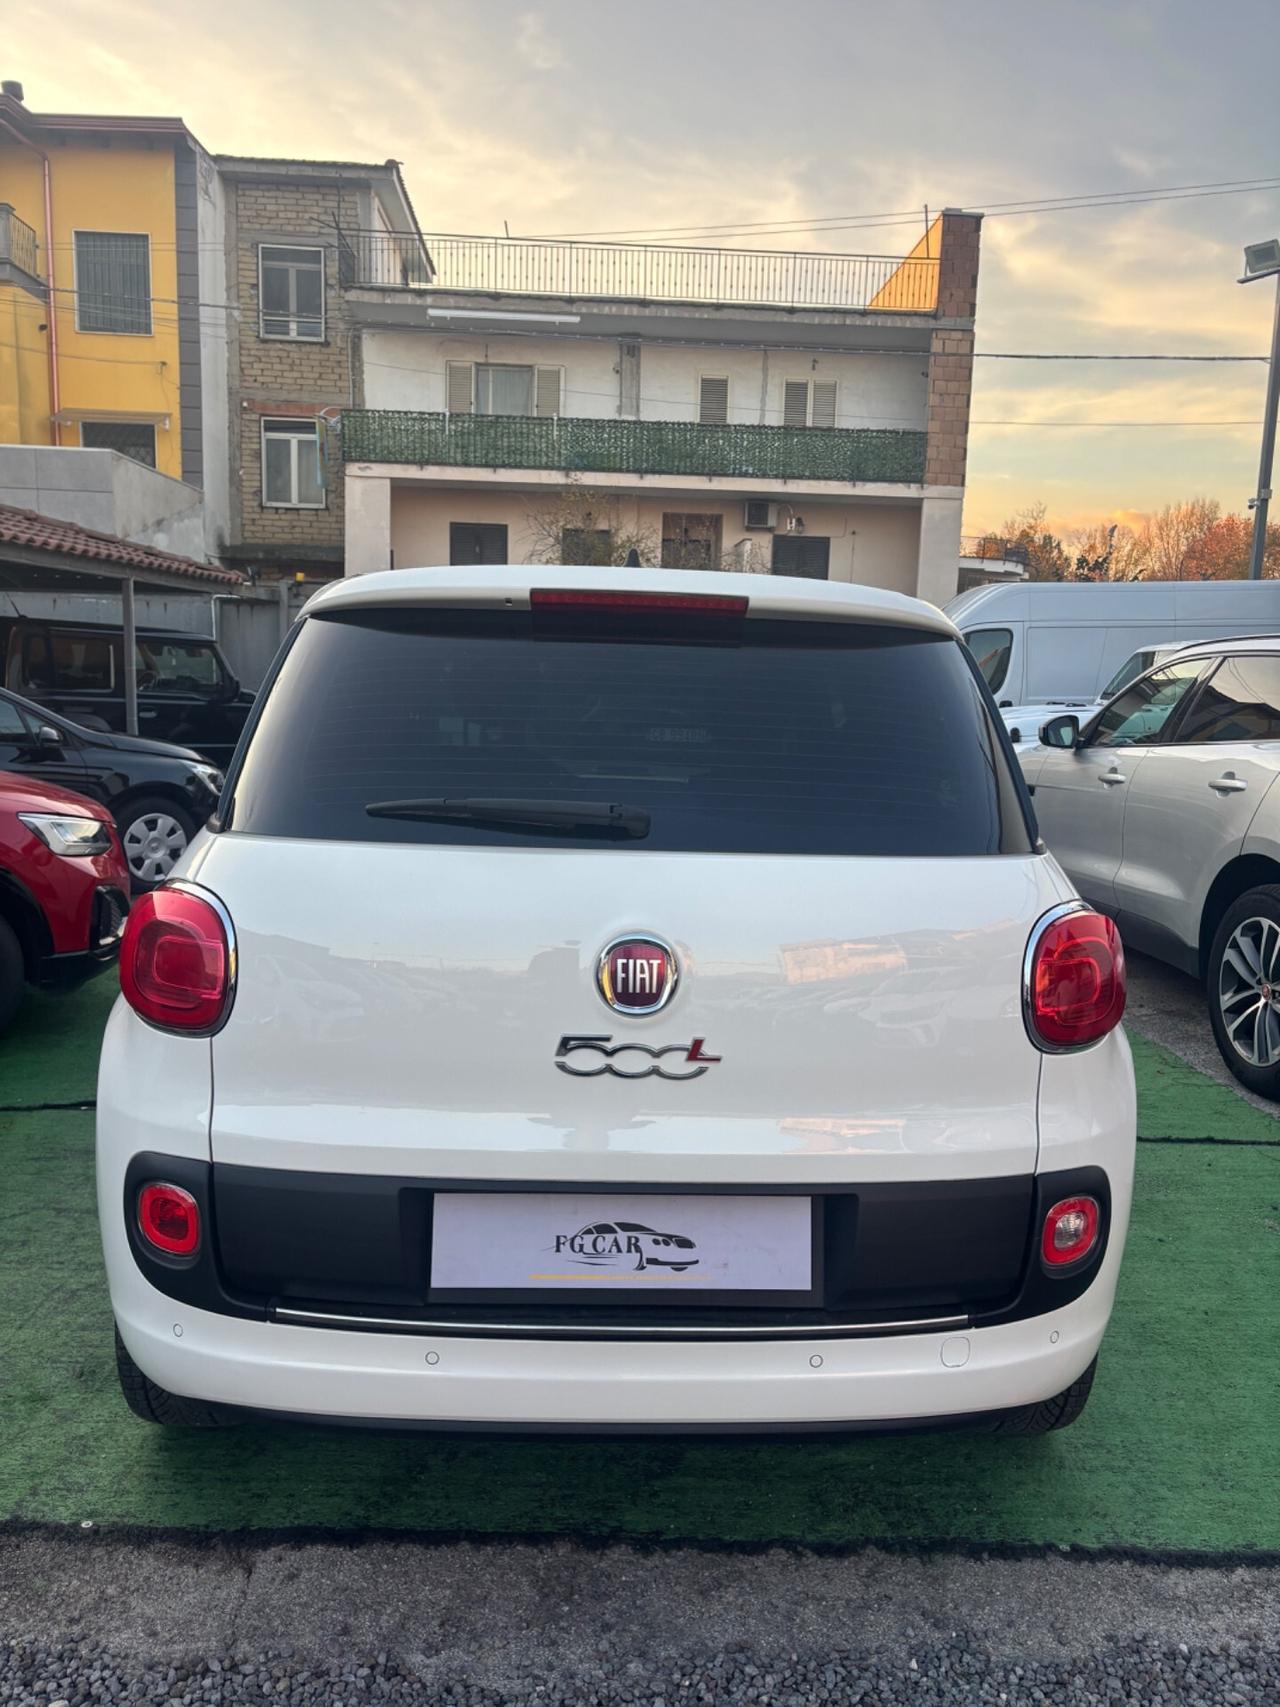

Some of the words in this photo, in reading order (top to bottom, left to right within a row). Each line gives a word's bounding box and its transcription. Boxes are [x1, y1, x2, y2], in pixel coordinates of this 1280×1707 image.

[616, 958, 662, 994] FIAT
[554, 1033, 723, 1081] 500L
[554, 1234, 585, 1254] FG
[591, 1234, 641, 1254] CAR
